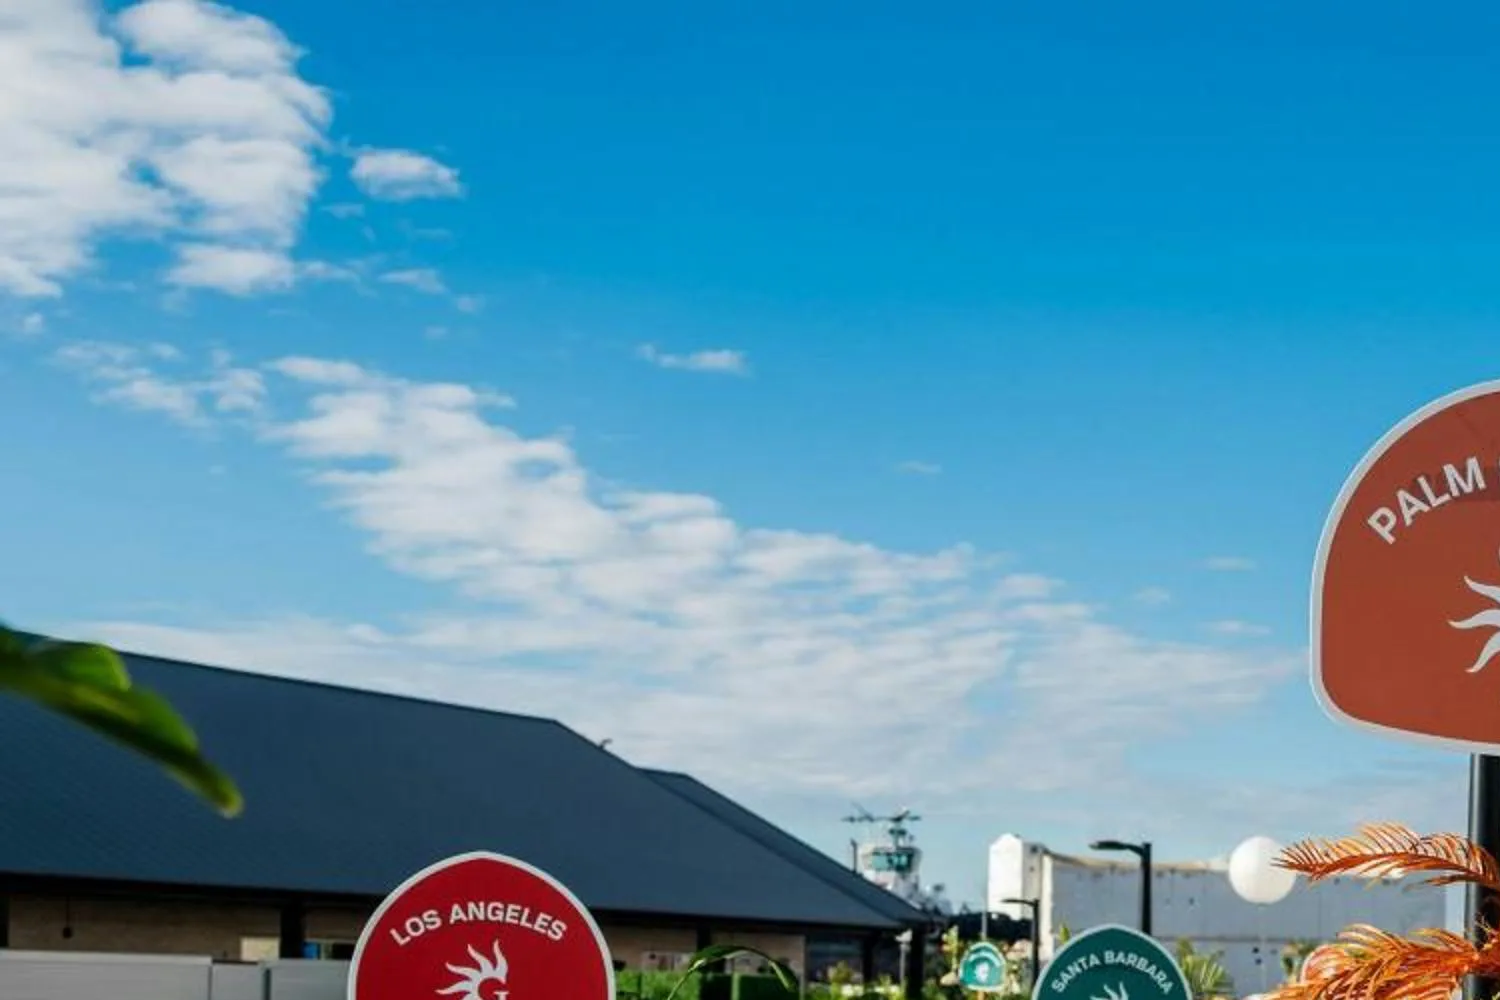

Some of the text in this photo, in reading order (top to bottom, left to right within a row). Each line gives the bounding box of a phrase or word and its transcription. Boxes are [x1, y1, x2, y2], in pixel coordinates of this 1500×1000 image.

[1367, 456, 1486, 545] PALM
[390, 901, 567, 946] LOS ANGELES
[1051, 950, 1174, 995] SANTA BARBARA
